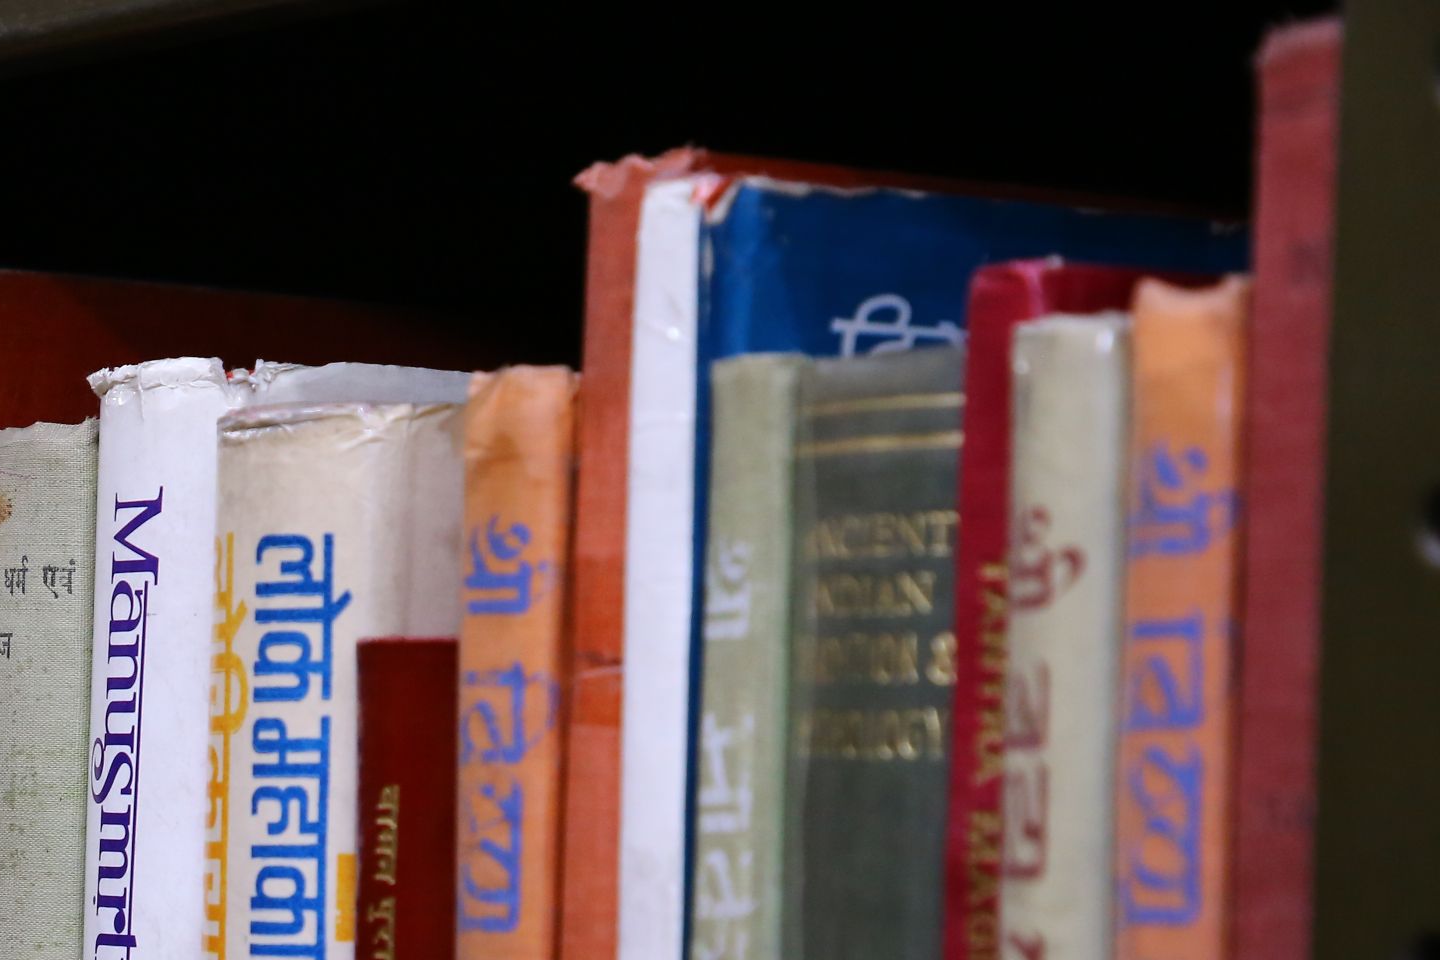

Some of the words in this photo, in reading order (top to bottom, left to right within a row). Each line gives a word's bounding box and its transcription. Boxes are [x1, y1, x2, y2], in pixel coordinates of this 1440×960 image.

[5, 555, 29, 595] धर्म
[42, 559, 77, 599] एवं
[251, 533, 354, 702] लोक
